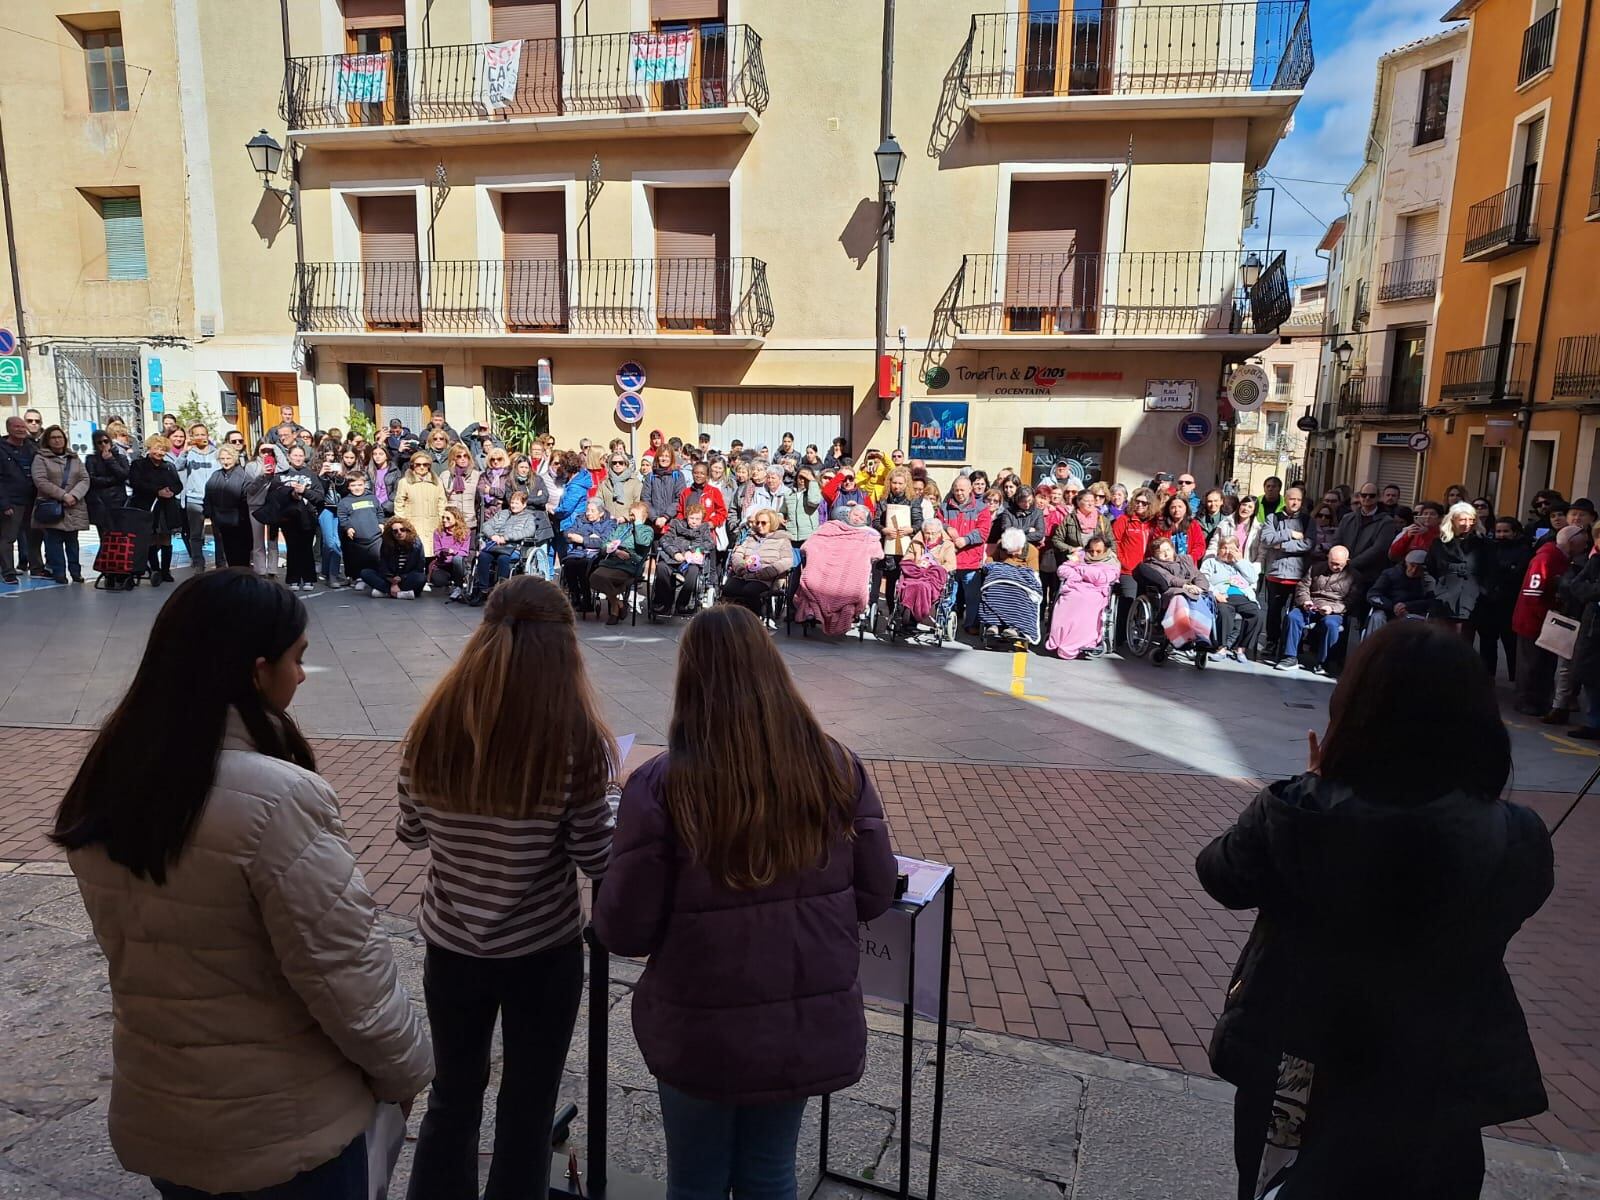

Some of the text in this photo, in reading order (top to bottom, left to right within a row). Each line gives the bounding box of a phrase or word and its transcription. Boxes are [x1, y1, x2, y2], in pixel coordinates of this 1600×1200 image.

[956, 366, 1008, 381] TonerTin
[1010, 367, 1020, 380] &
[995, 387, 1051, 396] COCENTAINA
[1530, 574, 1541, 589] 6
